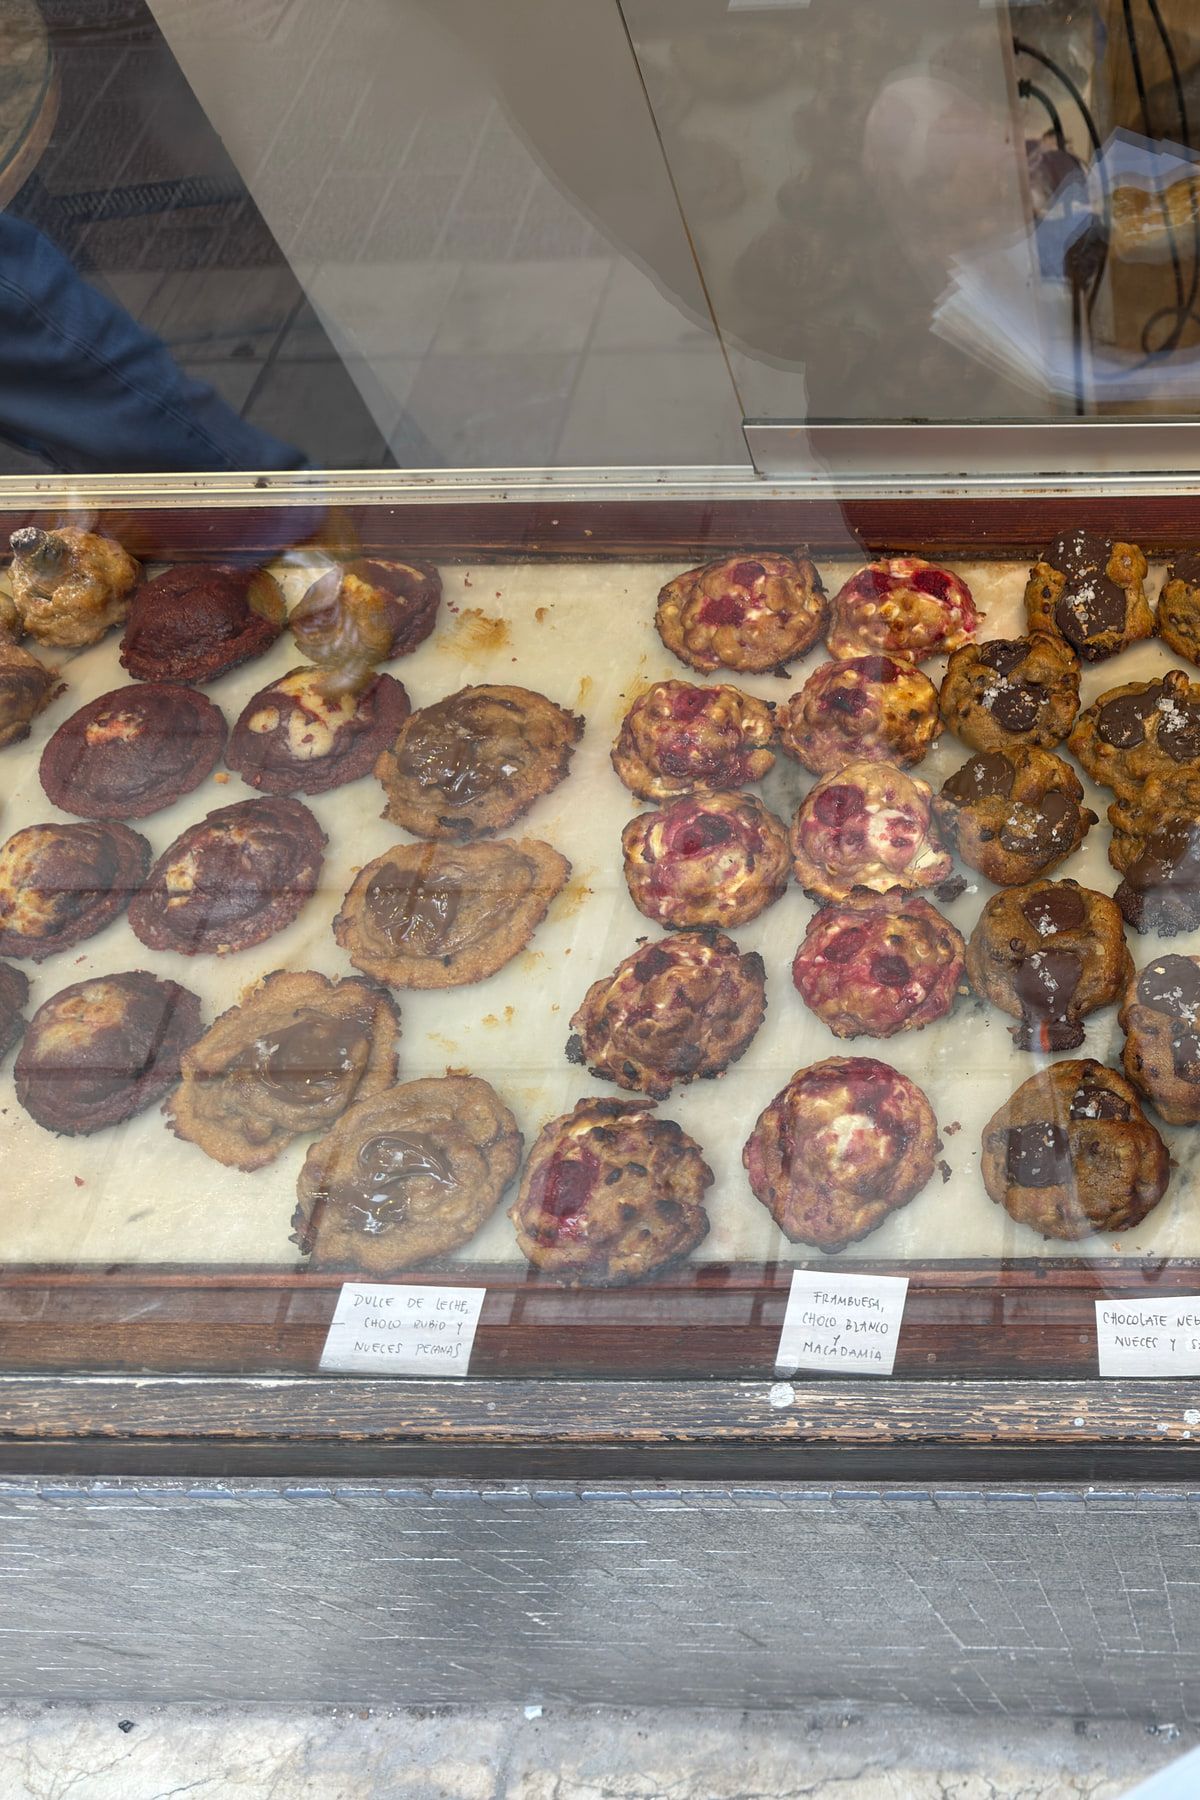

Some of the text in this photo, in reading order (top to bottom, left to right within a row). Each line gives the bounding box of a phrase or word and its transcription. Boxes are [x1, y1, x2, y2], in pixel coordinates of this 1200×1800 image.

[353, 1294, 470, 1314] DULCE DE LECHE,
[813, 1291, 884, 1313] FRAMBUESA,
[364, 1317, 401, 1329] CHOCO
[457, 1321, 463, 1335] Y
[802, 1311, 889, 1334] CHOCO BLANCO
[1103, 1312, 1168, 1327] CHOCOLATE
[354, 1341, 462, 1358] NUECES PECANAS
[833, 1335, 841, 1346] Y
[1114, 1336, 1159, 1349] NUECES
[1170, 1338, 1177, 1352] Y
[803, 1341, 882, 1361] MACADAMIA
